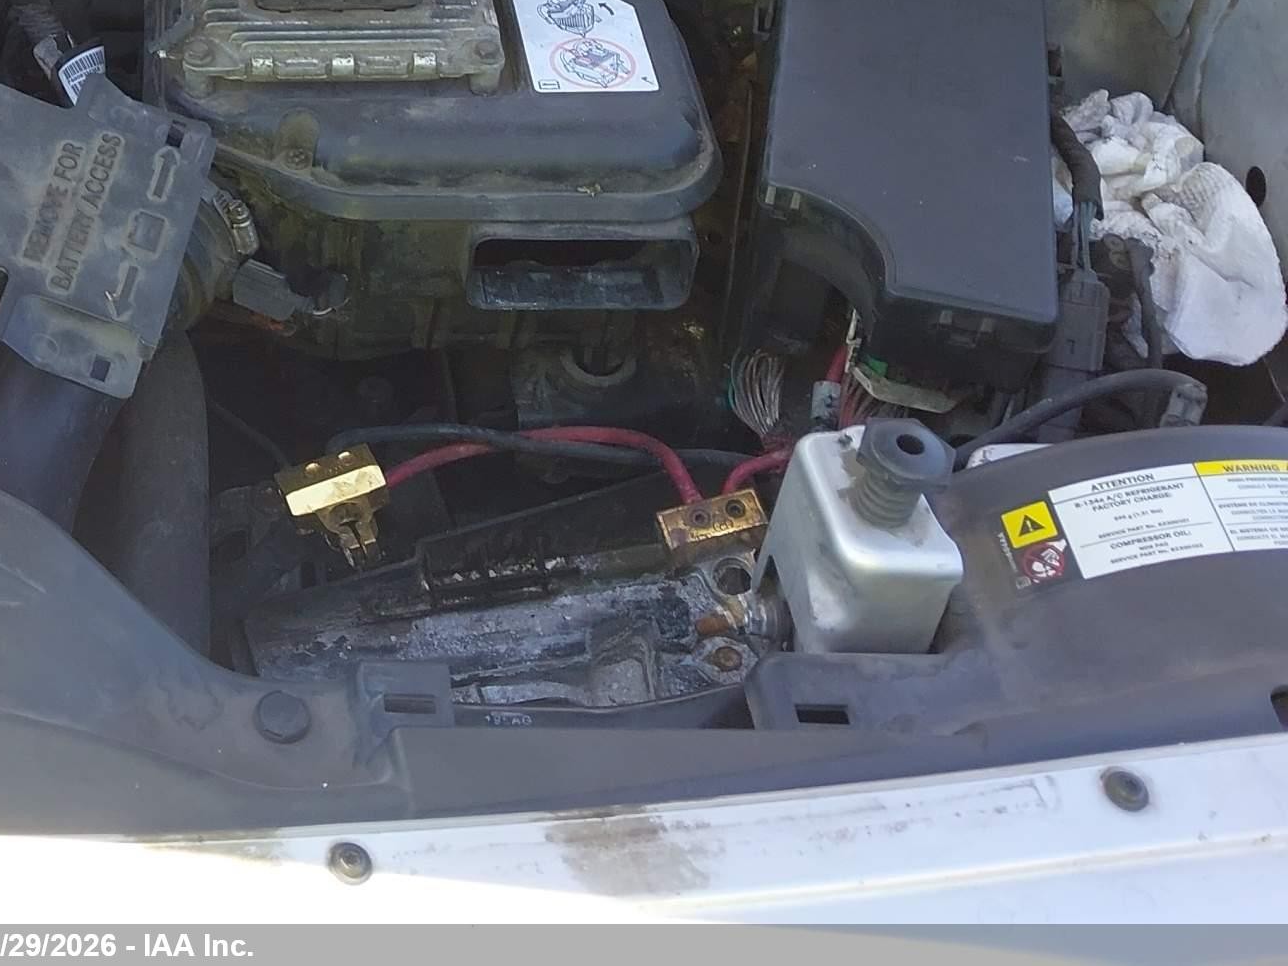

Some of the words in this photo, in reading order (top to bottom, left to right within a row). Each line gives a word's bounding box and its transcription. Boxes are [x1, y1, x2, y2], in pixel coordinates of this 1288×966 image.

[23, 183, 69, 264] REMOVE
[53, 142, 84, 182] FOR
[50, 208, 96, 291] BATTERY
[81, 133, 121, 210] ACCESS
[1222, 464, 1280, 473] WARNING
[1091, 473, 1155, 492] ATTENTION
[1106, 491, 1124, 503] A/C
[1125, 483, 1185, 498] REFRIGERANT
[1092, 498, 1132, 513] FACTORY
[1110, 532, 1173, 550] COMPRESSOR
[1174, 529, 1192, 539] OIL:
